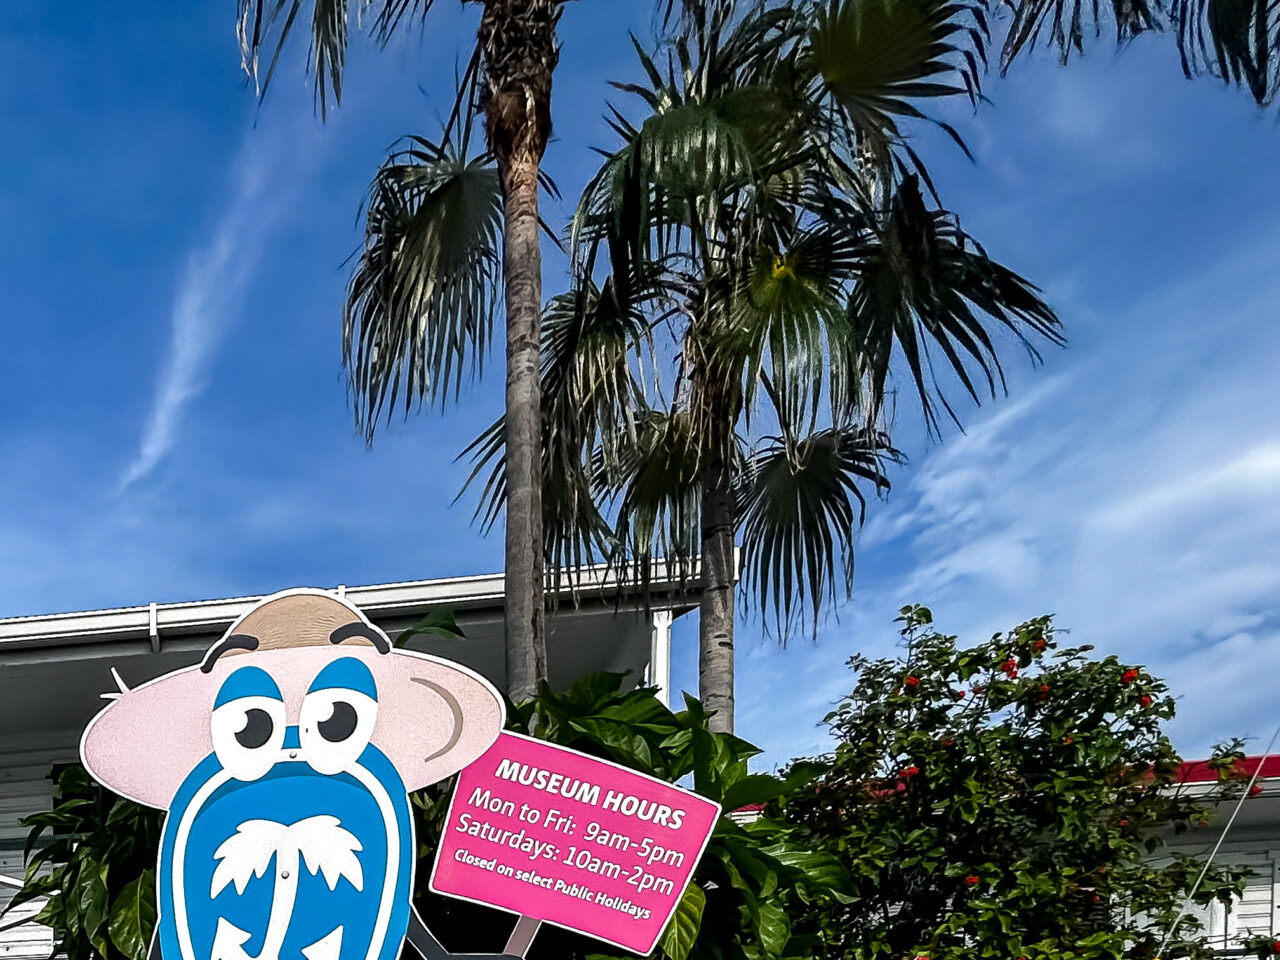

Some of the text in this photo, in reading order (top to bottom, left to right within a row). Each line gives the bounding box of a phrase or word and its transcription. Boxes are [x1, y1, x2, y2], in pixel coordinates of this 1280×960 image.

[468, 788, 685, 868] Mon to Fri: 9am-5pm
[495, 759, 686, 830] MUSEUM HOURS
[455, 849, 651, 919] Closed on select Public Holidays
[456, 813, 674, 895] Saturdays: 10am-2pm
